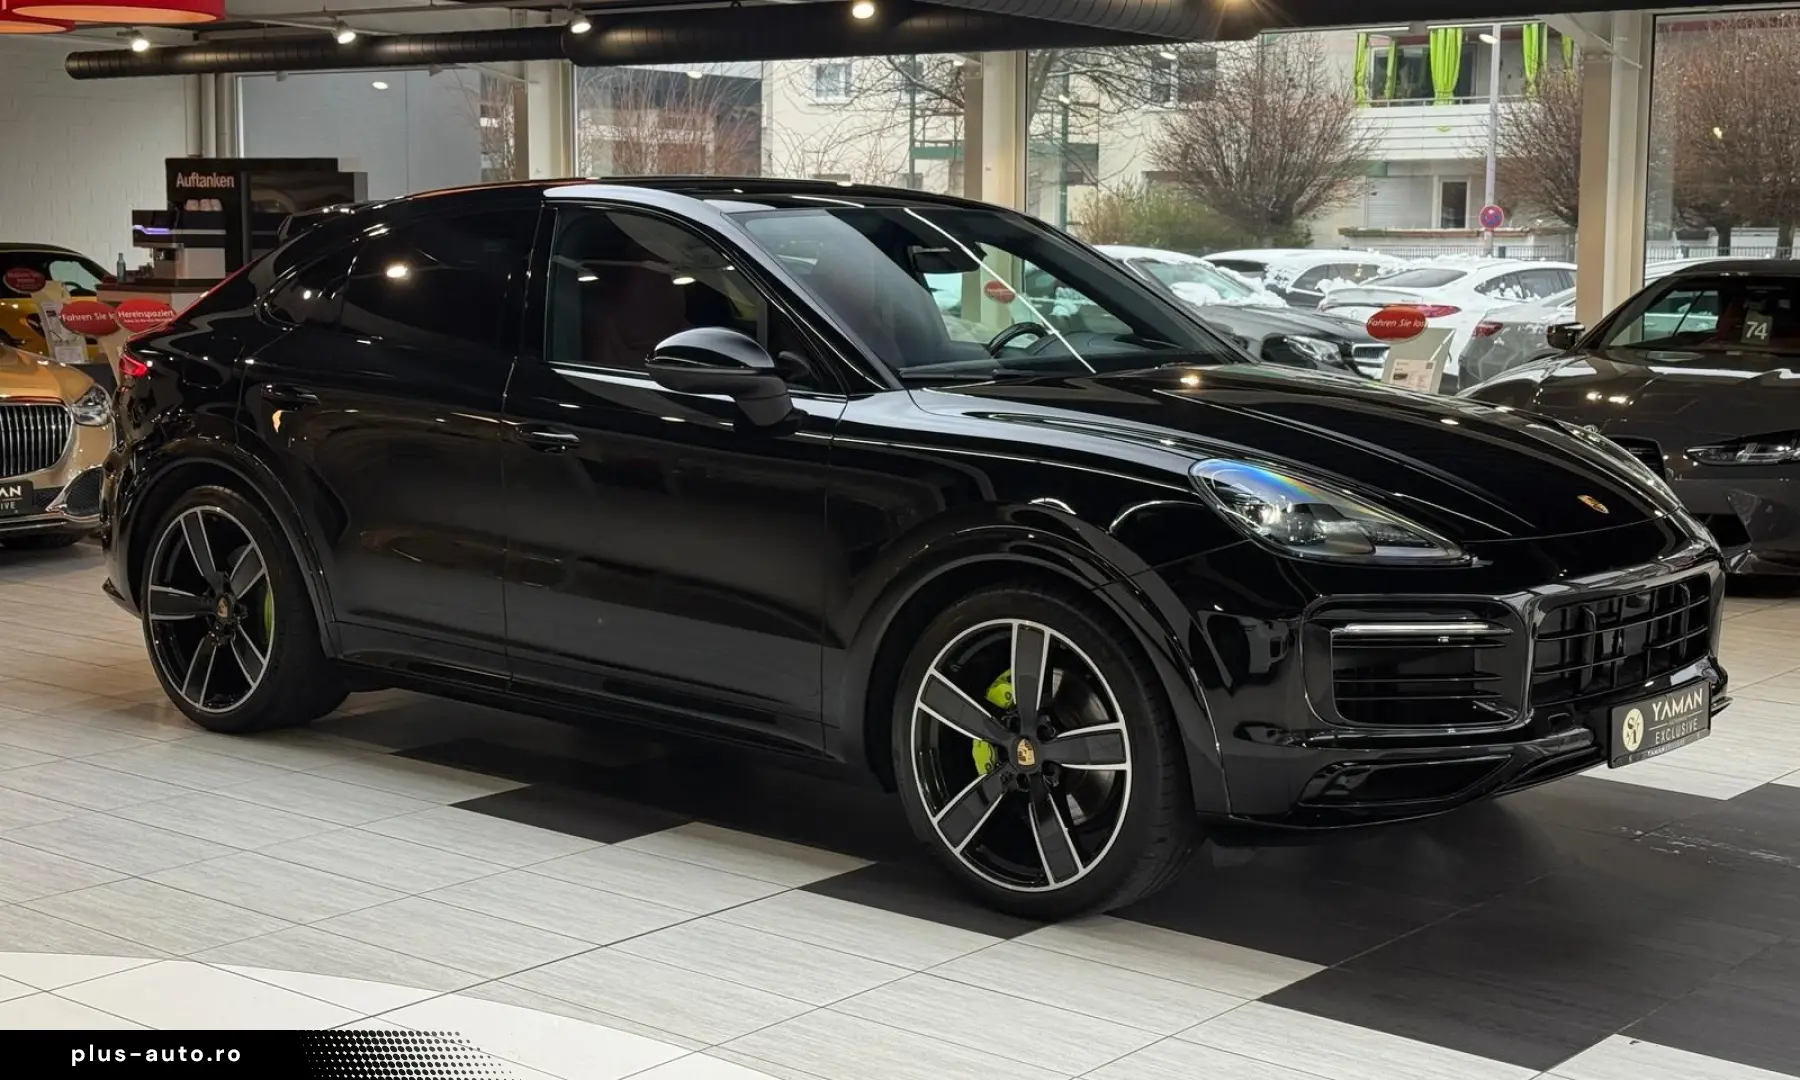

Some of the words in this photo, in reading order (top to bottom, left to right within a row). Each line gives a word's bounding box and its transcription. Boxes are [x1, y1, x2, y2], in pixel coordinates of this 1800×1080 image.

[176, 172, 235, 189] Auftanken
[62, 313, 92, 322] Fahren
[94, 312, 107, 320] Sie
[1368, 318, 1397, 328] Fahren
[1398, 317, 1412, 328] Sie
[1746, 321, 1768, 340] 74
[0, 485, 21, 497] AN
[0, 501, 16, 510] IVE
[1652, 687, 1703, 721] YAMAN
[1655, 718, 1698, 745] EXCLUSIVE
